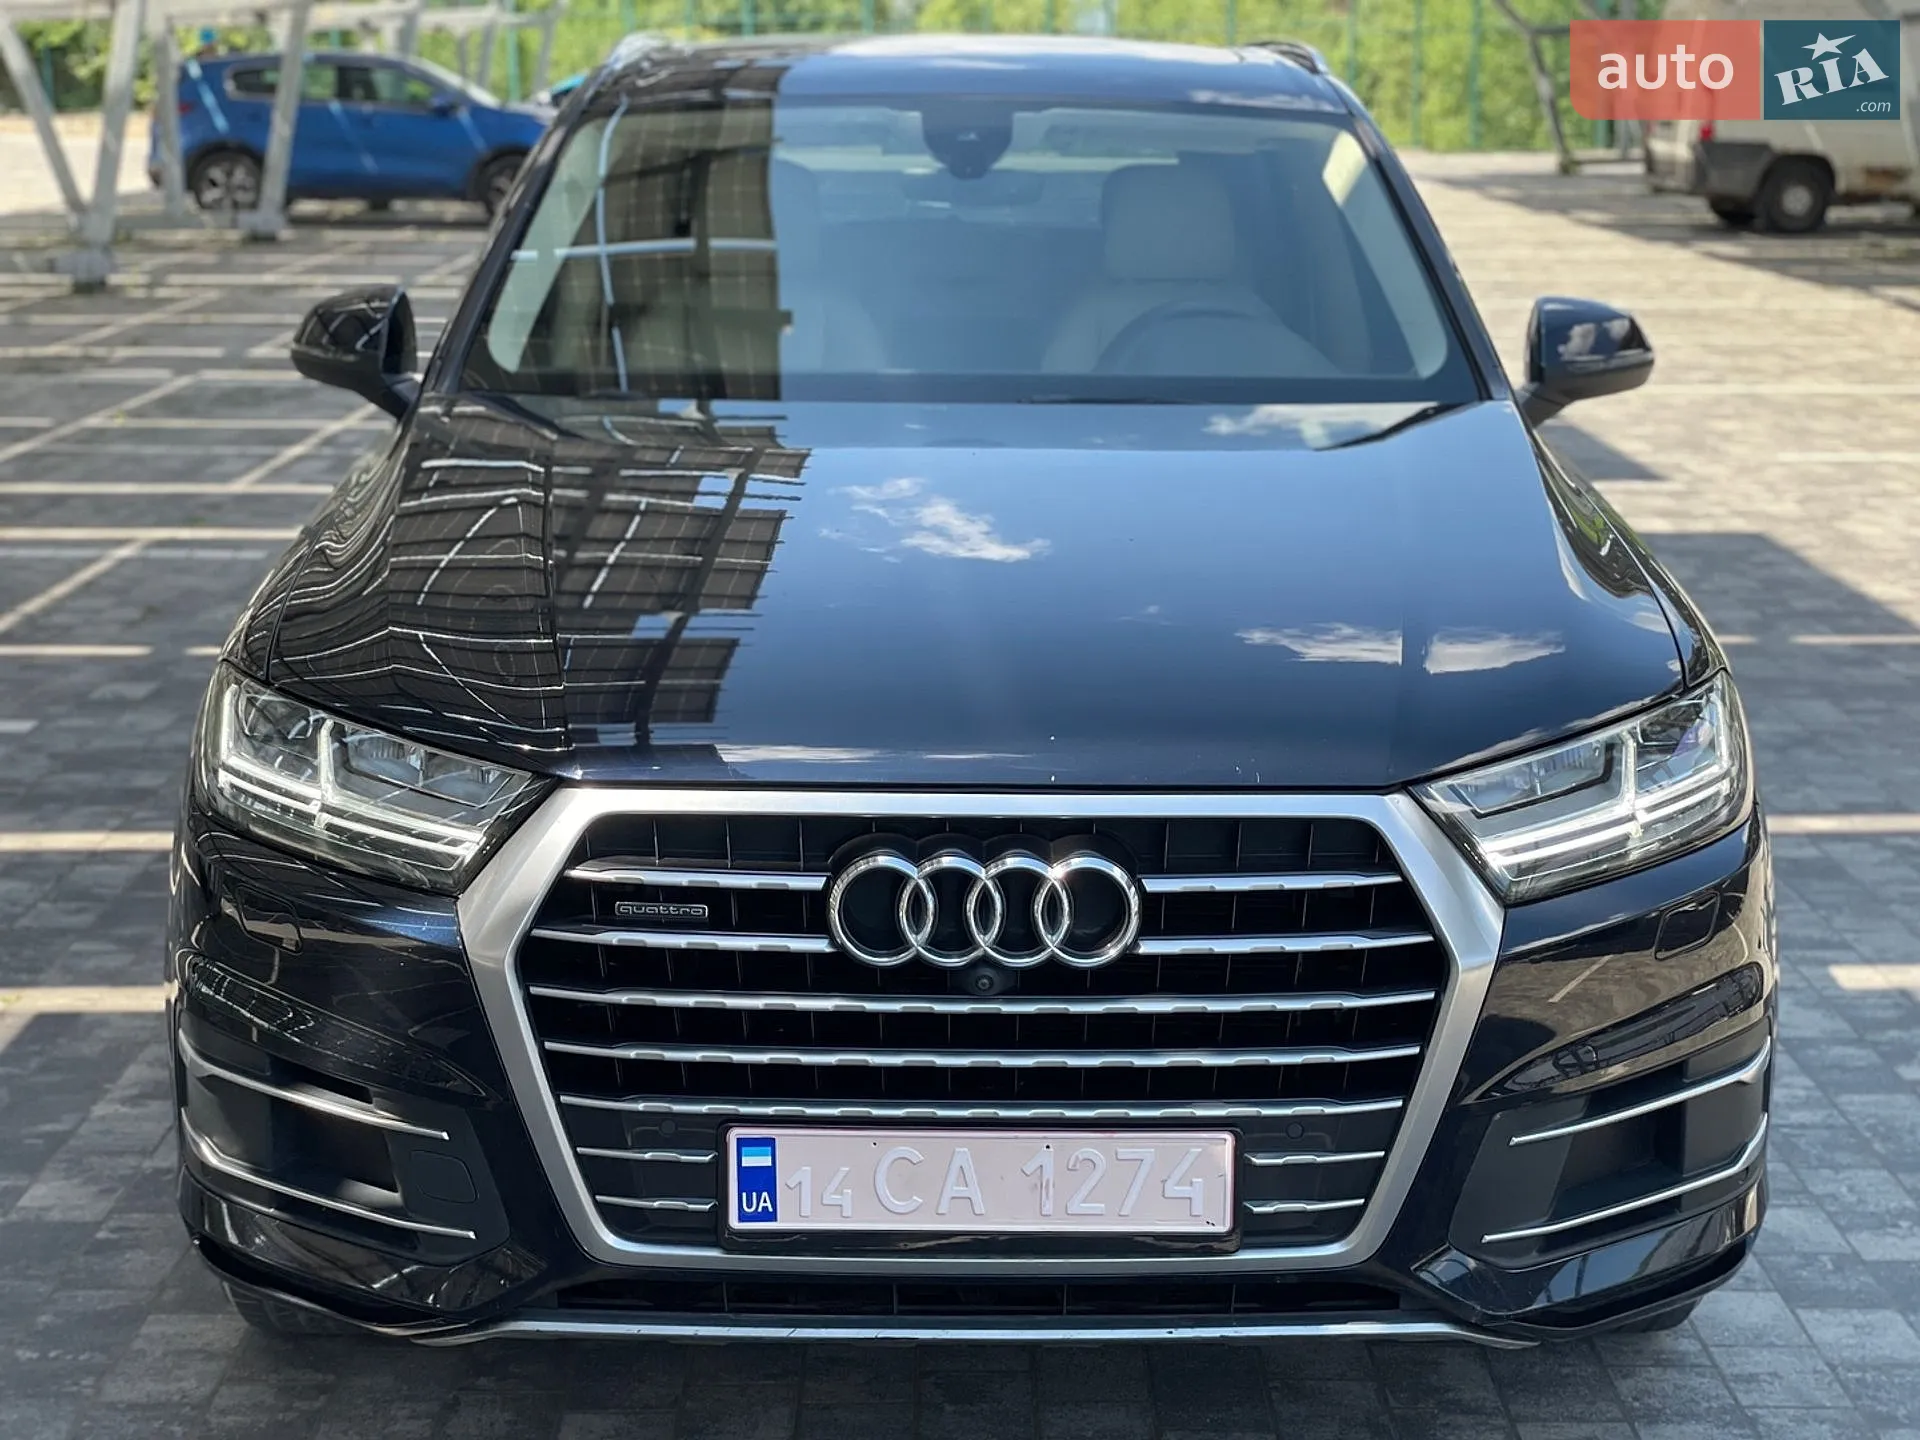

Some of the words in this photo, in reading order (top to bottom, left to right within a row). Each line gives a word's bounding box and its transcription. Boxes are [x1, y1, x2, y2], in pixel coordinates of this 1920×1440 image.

[619, 904, 704, 916] quattro
[784, 1166, 852, 1218] 14
[872, 1146, 986, 1217] CA
[1020, 1147, 1205, 1217] 1274
[741, 1191, 774, 1214] UA
